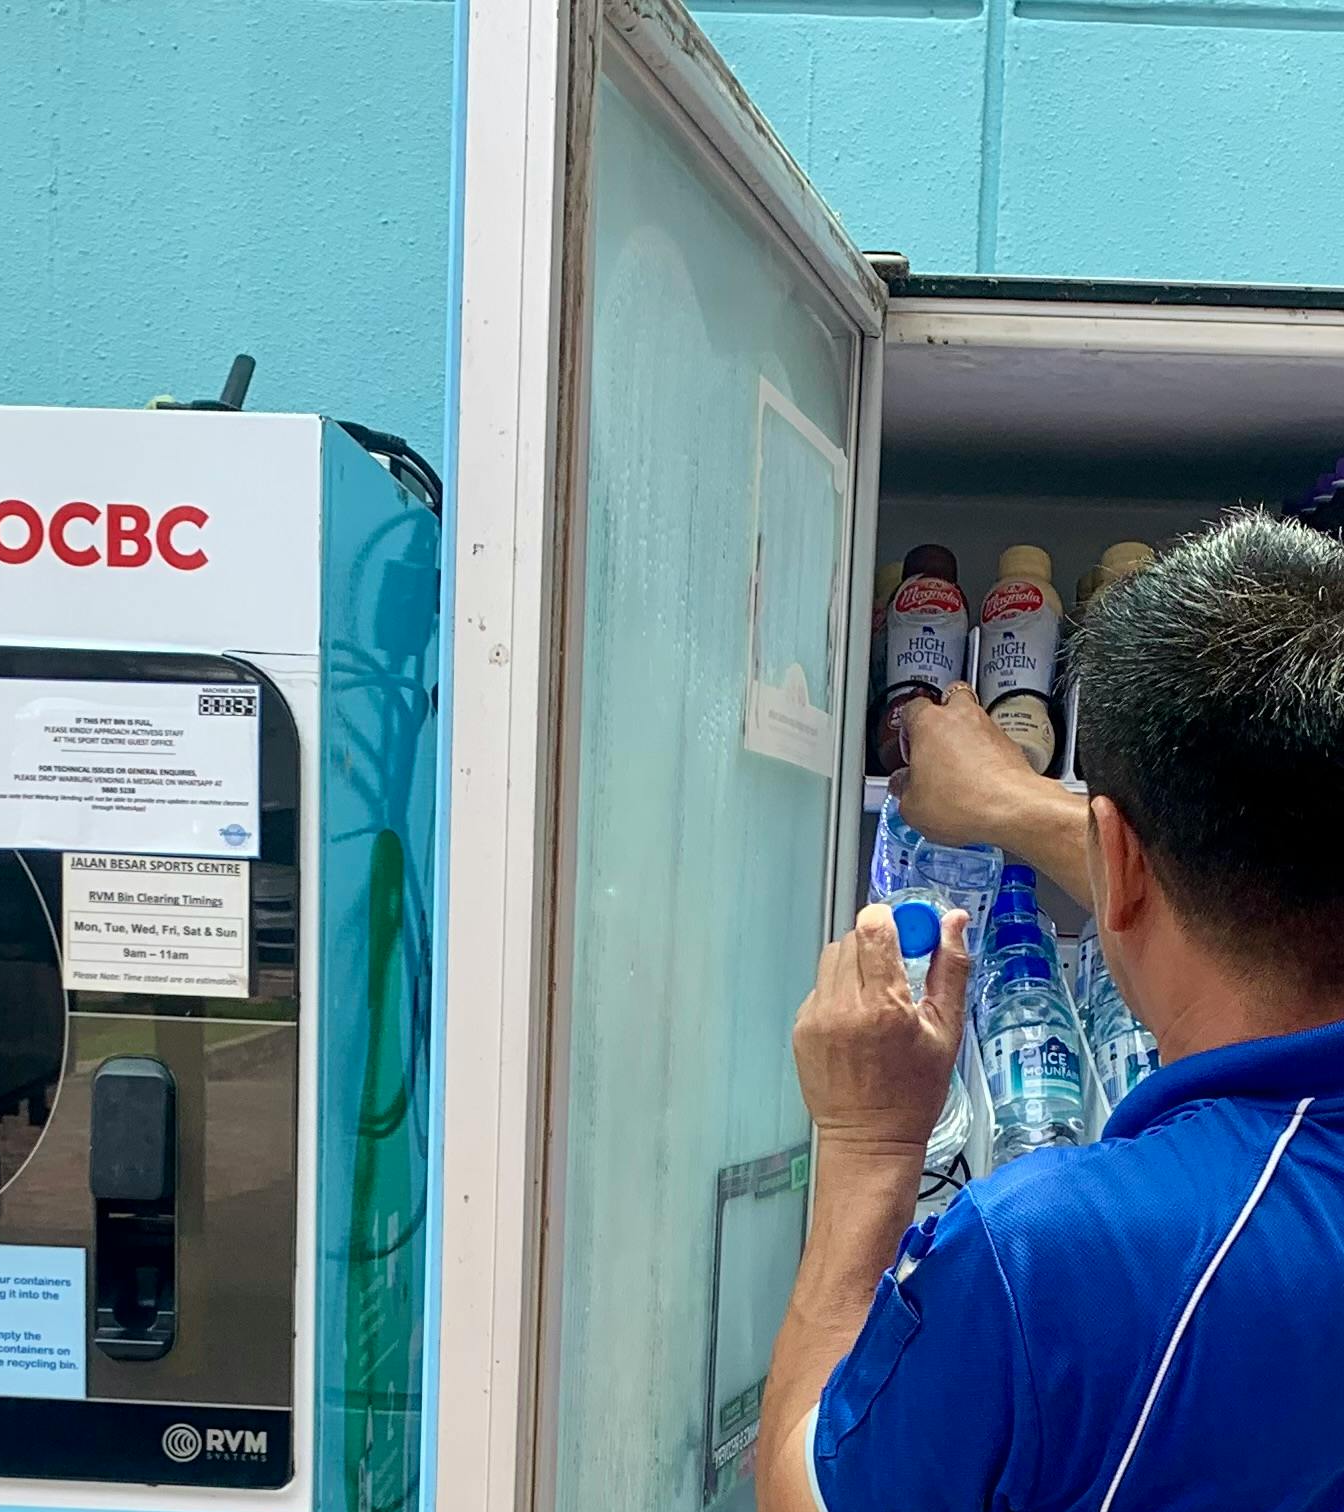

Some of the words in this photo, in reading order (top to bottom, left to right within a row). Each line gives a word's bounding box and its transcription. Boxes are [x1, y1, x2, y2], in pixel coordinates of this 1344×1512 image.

[904, 586, 959, 608] Magnolia
[908, 637, 945, 652] HIGH
[992, 642, 1026, 659] HIGH
[897, 650, 954, 671] PROTEIN
[983, 656, 1037, 677] PROTEIN
[71, 857, 107, 869] JALAN
[111, 859, 146, 870] BESAR
[150, 861, 193, 872] SPORTS
[197, 863, 240, 874] CENTRE
[89, 891, 114, 901] RVM
[118, 892, 134, 902] Bin
[137, 893, 180, 905] Clearing
[182, 895, 223, 907] Timings
[74, 921, 101, 933] Mon,
[105, 923, 129, 934] Tue,
[132, 924, 159, 936] Wed,
[162, 926, 180, 936] Fri,
[184, 927, 201, 937] Sat
[205, 927, 212, 936] &
[216, 928, 237, 938] Sun
[124, 949, 146, 959] 9am
[160, 950, 189, 960] 11am
[1042, 1051, 1066, 1066] ICE
[13, 1276, 71, 1287] containers
[9, 1288, 17, 1298] it
[19, 1289, 40, 1300] into
[42, 1290, 59, 1301] the
[24, 1331, 41, 1341] the
[206, 1428, 267, 1453] RVM
[206, 1452, 267, 1462] SYSTEMS
